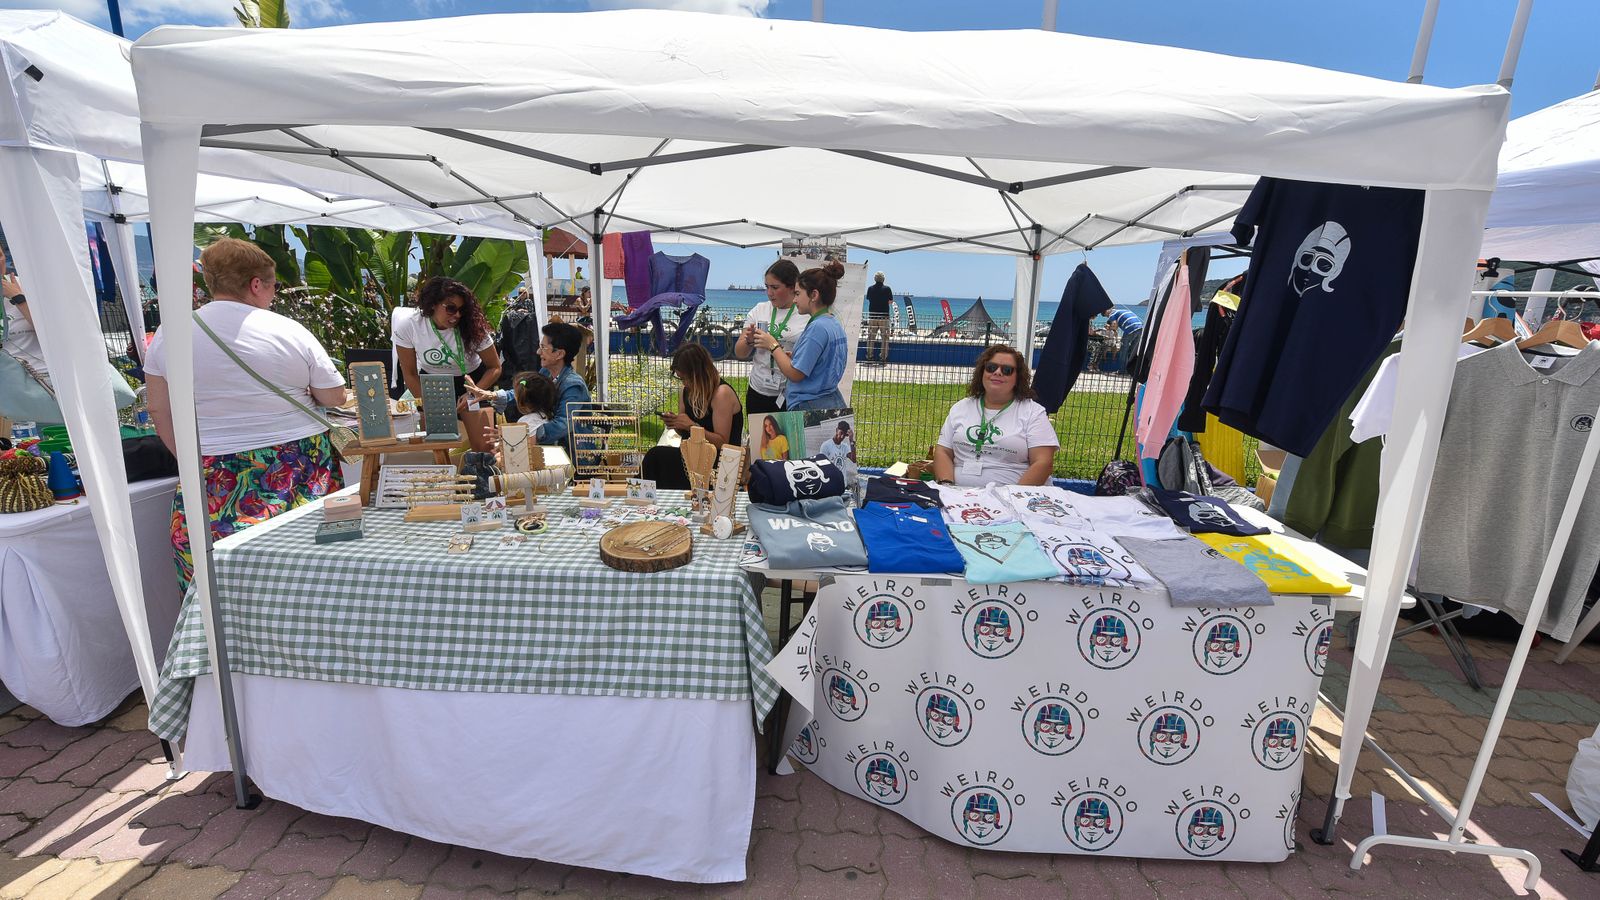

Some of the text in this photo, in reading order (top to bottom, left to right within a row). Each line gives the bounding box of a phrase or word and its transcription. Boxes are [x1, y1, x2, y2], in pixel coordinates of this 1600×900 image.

[843, 579, 926, 612] WEIRDO
[951, 584, 1039, 622] WEIRDO
[1066, 592, 1154, 630] WEIRDO
[1181, 607, 1266, 635] WEDO
[814, 654, 880, 693] WEIRDO
[905, 671, 986, 711] WEIRDO
[1011, 682, 1100, 720] WEIRDO
[1126, 691, 1215, 727] WEIRDO
[845, 740, 919, 782] WEIRDO
[940, 770, 1025, 807] WEIRDO
[1051, 777, 1138, 813] WEIRDO
[1164, 785, 1251, 820] WEIRDO
